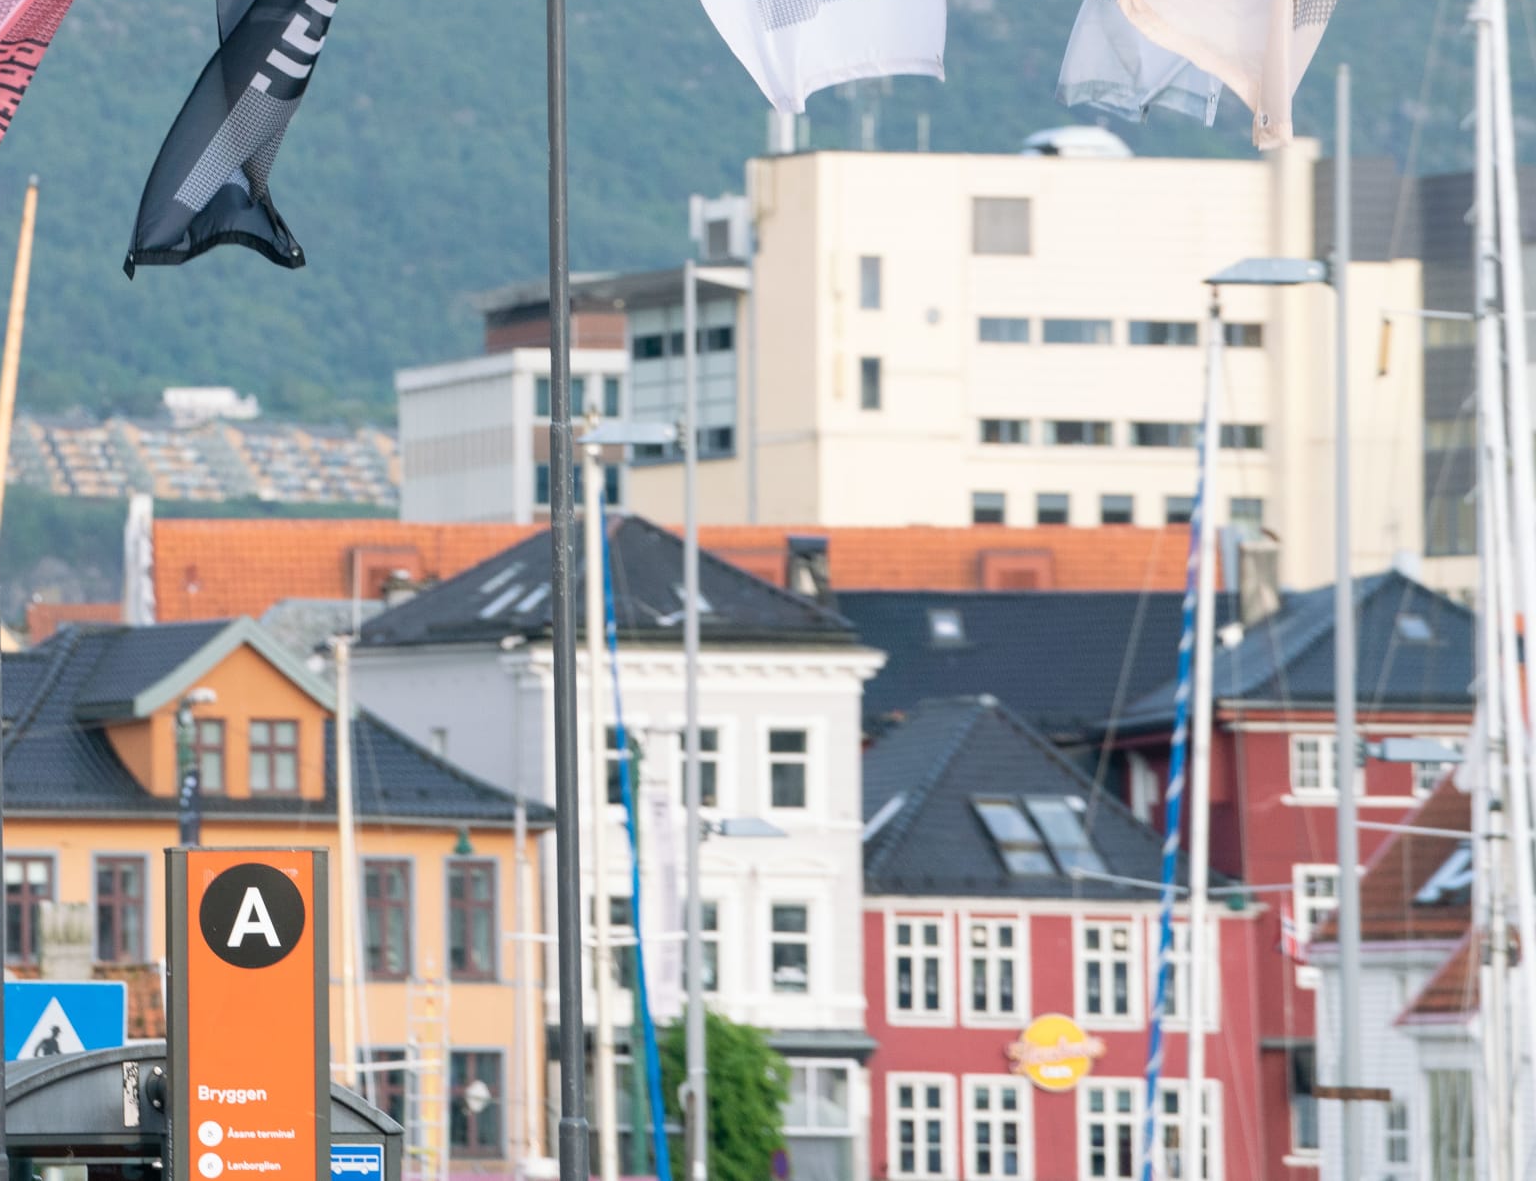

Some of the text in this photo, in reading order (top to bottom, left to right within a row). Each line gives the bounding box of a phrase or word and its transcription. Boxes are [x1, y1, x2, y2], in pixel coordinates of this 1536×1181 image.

[226, 886, 282, 948] A
[197, 1084, 268, 1105] Bryggen
[257, 1128, 296, 1139] terminal
